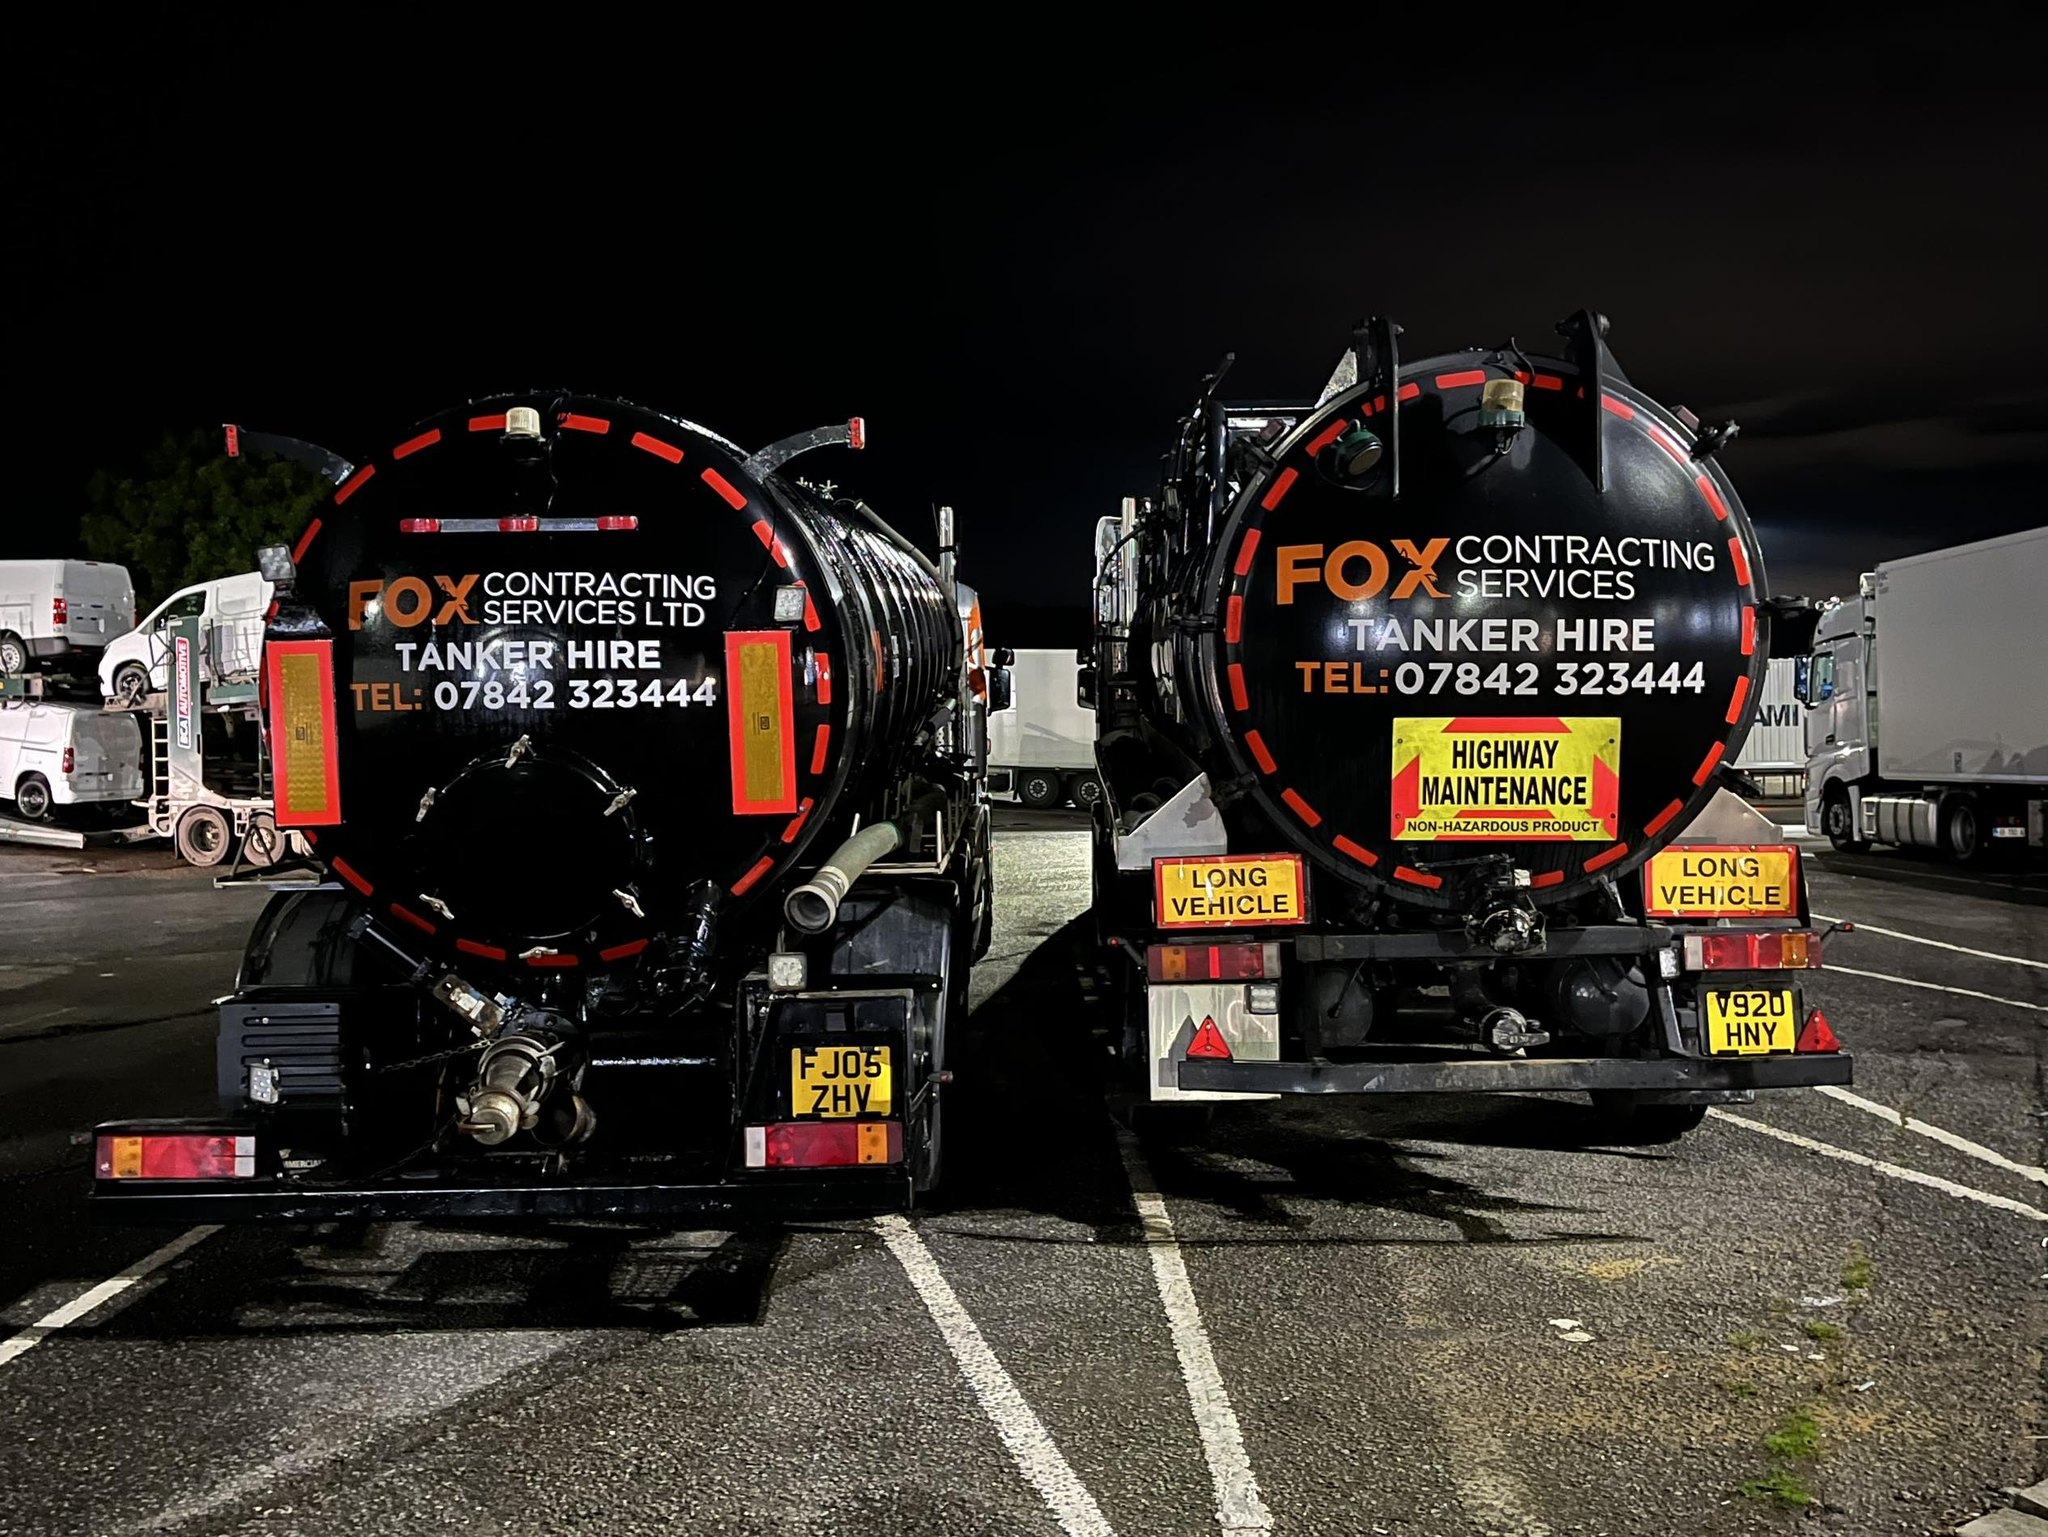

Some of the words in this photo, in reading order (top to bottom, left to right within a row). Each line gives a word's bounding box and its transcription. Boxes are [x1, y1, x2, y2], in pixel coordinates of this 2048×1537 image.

[1455, 535, 1715, 572] CONTRACTING
[483, 571, 717, 600] CONTRACTING
[1277, 537, 1452, 605] FOX
[1456, 569, 1636, 601] SERVICES
[348, 574, 481, 631] FOX
[483, 600, 636, 625] SERVICES
[645, 601, 706, 627] LTD
[1347, 618, 1540, 652] TANKER
[1556, 618, 1656, 652] HIRE
[395, 641, 553, 672] TANKER
[567, 640, 662, 670] HIRE
[178, 641, 188, 714] AUTOMOTIVE
[1295, 661, 1389, 694] TEL:
[1395, 661, 1539, 695] 07842
[1554, 661, 1706, 696] 323444
[351, 683, 422, 711] TEL:
[434, 680, 556, 711] 07842
[568, 677, 717, 709] 323444
[1452, 740, 1559, 769] HIGHWAY
[1422, 776, 1587, 806] MAINTENANCE
[1407, 821, 1529, 832] NON-HAZARDOUS
[1532, 820, 1600, 832] PRODUCT
[1192, 867, 1268, 888] LONG
[1682, 858, 1760, 878] LONG
[1171, 894, 1289, 916] VEHICLE
[1660, 885, 1781, 905] VEHICLE
[1716, 993, 1785, 1017] V920
[1726, 1022, 1777, 1046] HNY
[800, 1050, 882, 1080] FJ05
[811, 1084, 871, 1113] ZHV
